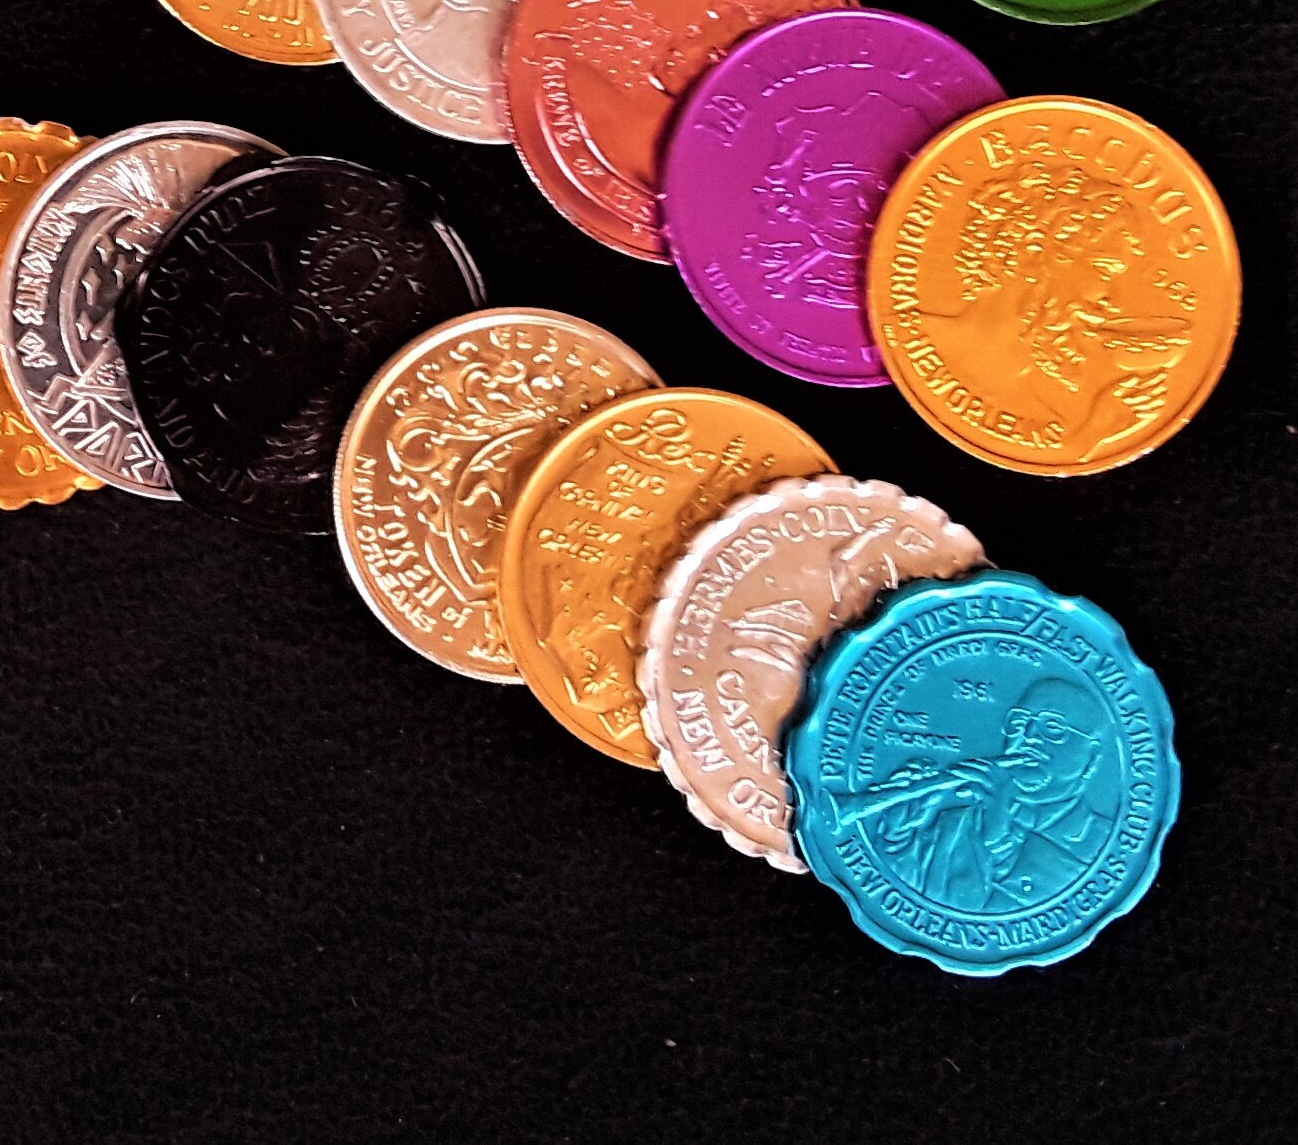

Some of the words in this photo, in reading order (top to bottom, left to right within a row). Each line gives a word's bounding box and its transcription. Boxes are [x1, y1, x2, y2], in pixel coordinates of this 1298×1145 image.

[670, 526, 775, 659] HERMES
[669, 687, 734, 780] NEW
[818, 707, 856, 782] PETE
[1092, 653, 1156, 775] WALKING
[1114, 780, 1155, 853] CLUB
[833, 834, 892, 898] NEW
